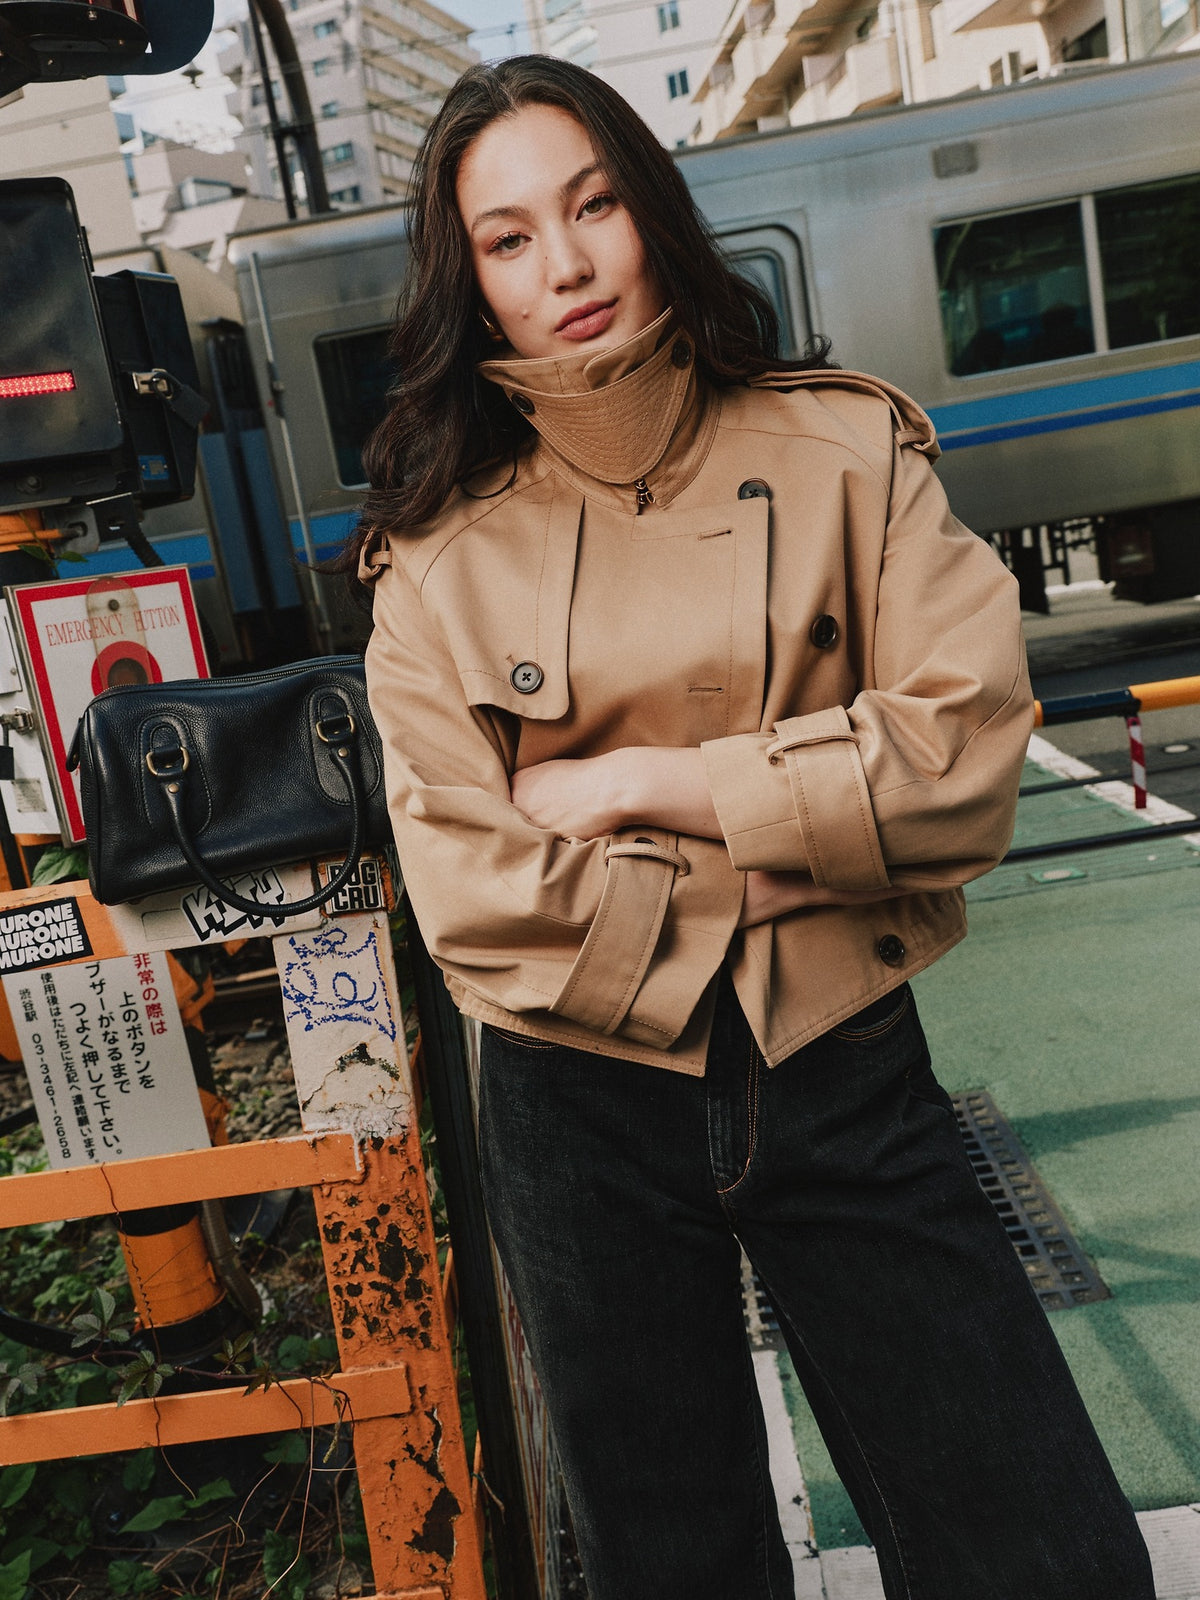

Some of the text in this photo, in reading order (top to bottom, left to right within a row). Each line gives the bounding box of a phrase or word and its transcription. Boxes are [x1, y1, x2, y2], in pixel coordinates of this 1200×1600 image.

[45, 613, 125, 647] EMERGENCY
[0, 902, 74, 934] URONE
[333, 885, 380, 911] CRU
[0, 934, 85, 969] MURONE
[132, 952, 168, 1036] 非常の際は
[85, 961, 131, 1094] ブザーがなるまで
[119, 991, 156, 1090] 上のボタンを
[69, 1002, 123, 1155] つよく押して下さい。
